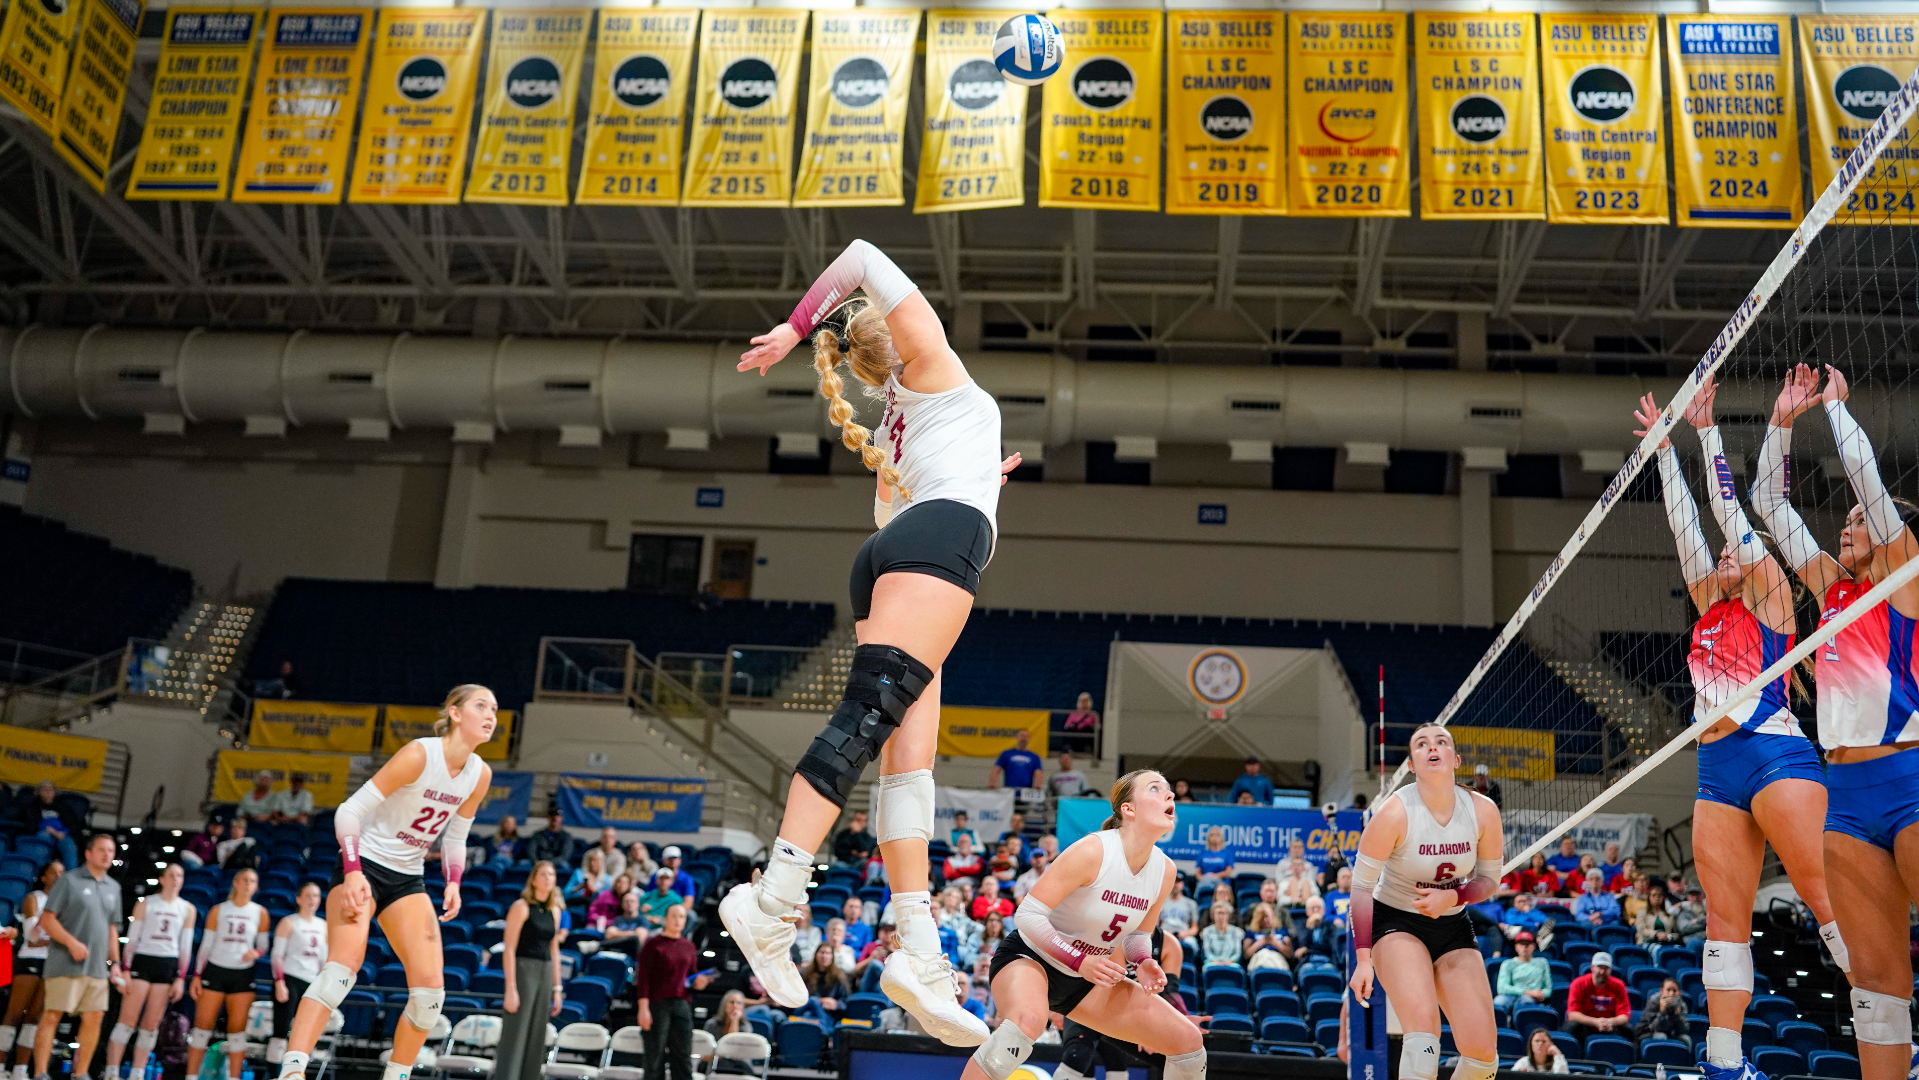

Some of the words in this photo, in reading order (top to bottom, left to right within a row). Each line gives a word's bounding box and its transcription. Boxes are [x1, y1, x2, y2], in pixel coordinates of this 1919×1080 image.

[1181, 22, 1211, 38] ASU
[1301, 23, 1330, 39] ASU
[1427, 22, 1457, 38] ASU
[1551, 24, 1581, 41] ASU
[1684, 26, 1713, 42] ASU
[1813, 27, 1845, 43] ASU
[1042, 21, 1055, 59] molten
[1554, 43, 1646, 54] VOLLEYBALL
[1687, 43, 1772, 54] VOLLEYBALL
[1816, 45, 1915, 56] VOLLEYBALL
[1182, 75, 1272, 91] CHAMPION
[1304, 77, 1394, 94] CHAMPION
[1431, 75, 1522, 91] CHAMPION
[1688, 73, 1728, 92] LONE
[1735, 73, 1776, 92] STAR
[1575, 91, 1633, 110] NCAA
[1684, 97, 1785, 116] CONFERENCE
[1456, 116, 1505, 133] NCAA
[1692, 121, 1778, 140] CHAMPION
[1839, 112, 1890, 194] ANGELO
[1889, 66, 1919, 127] STA
[1554, 128, 1596, 144] South
[1600, 128, 1657, 145] Central
[1580, 147, 1632, 164] Region
[491, 173, 546, 194] 2013
[602, 175, 659, 195] 2014
[709, 175, 767, 196] 2015
[821, 175, 879, 196] 2016
[942, 175, 997, 199] 2017
[1069, 178, 1129, 199] 2018
[1198, 183, 1259, 203] 2019
[1708, 178, 1769, 199] 2024
[1316, 184, 1381, 204] 2020
[1452, 187, 1513, 208] 2021
[1575, 190, 1640, 211] 2023
[1847, 192, 1915, 212] 2024
[810, 309, 823, 326] UP
[423, 788, 464, 806] OKLAHOMA
[411, 807, 450, 835] 22
[1188, 824, 1264, 849] LEDING
[1267, 827, 1303, 850] THE
[1418, 841, 1471, 856] OKLAHOMA
[1434, 862, 1456, 882] 6
[1101, 889, 1149, 911] OKLAHOMA
[160, 920, 170, 933] 3
[1101, 913, 1129, 943] 5
[1051, 936, 1074, 954] TALONS
[1070, 947, 1082, 958] UP
